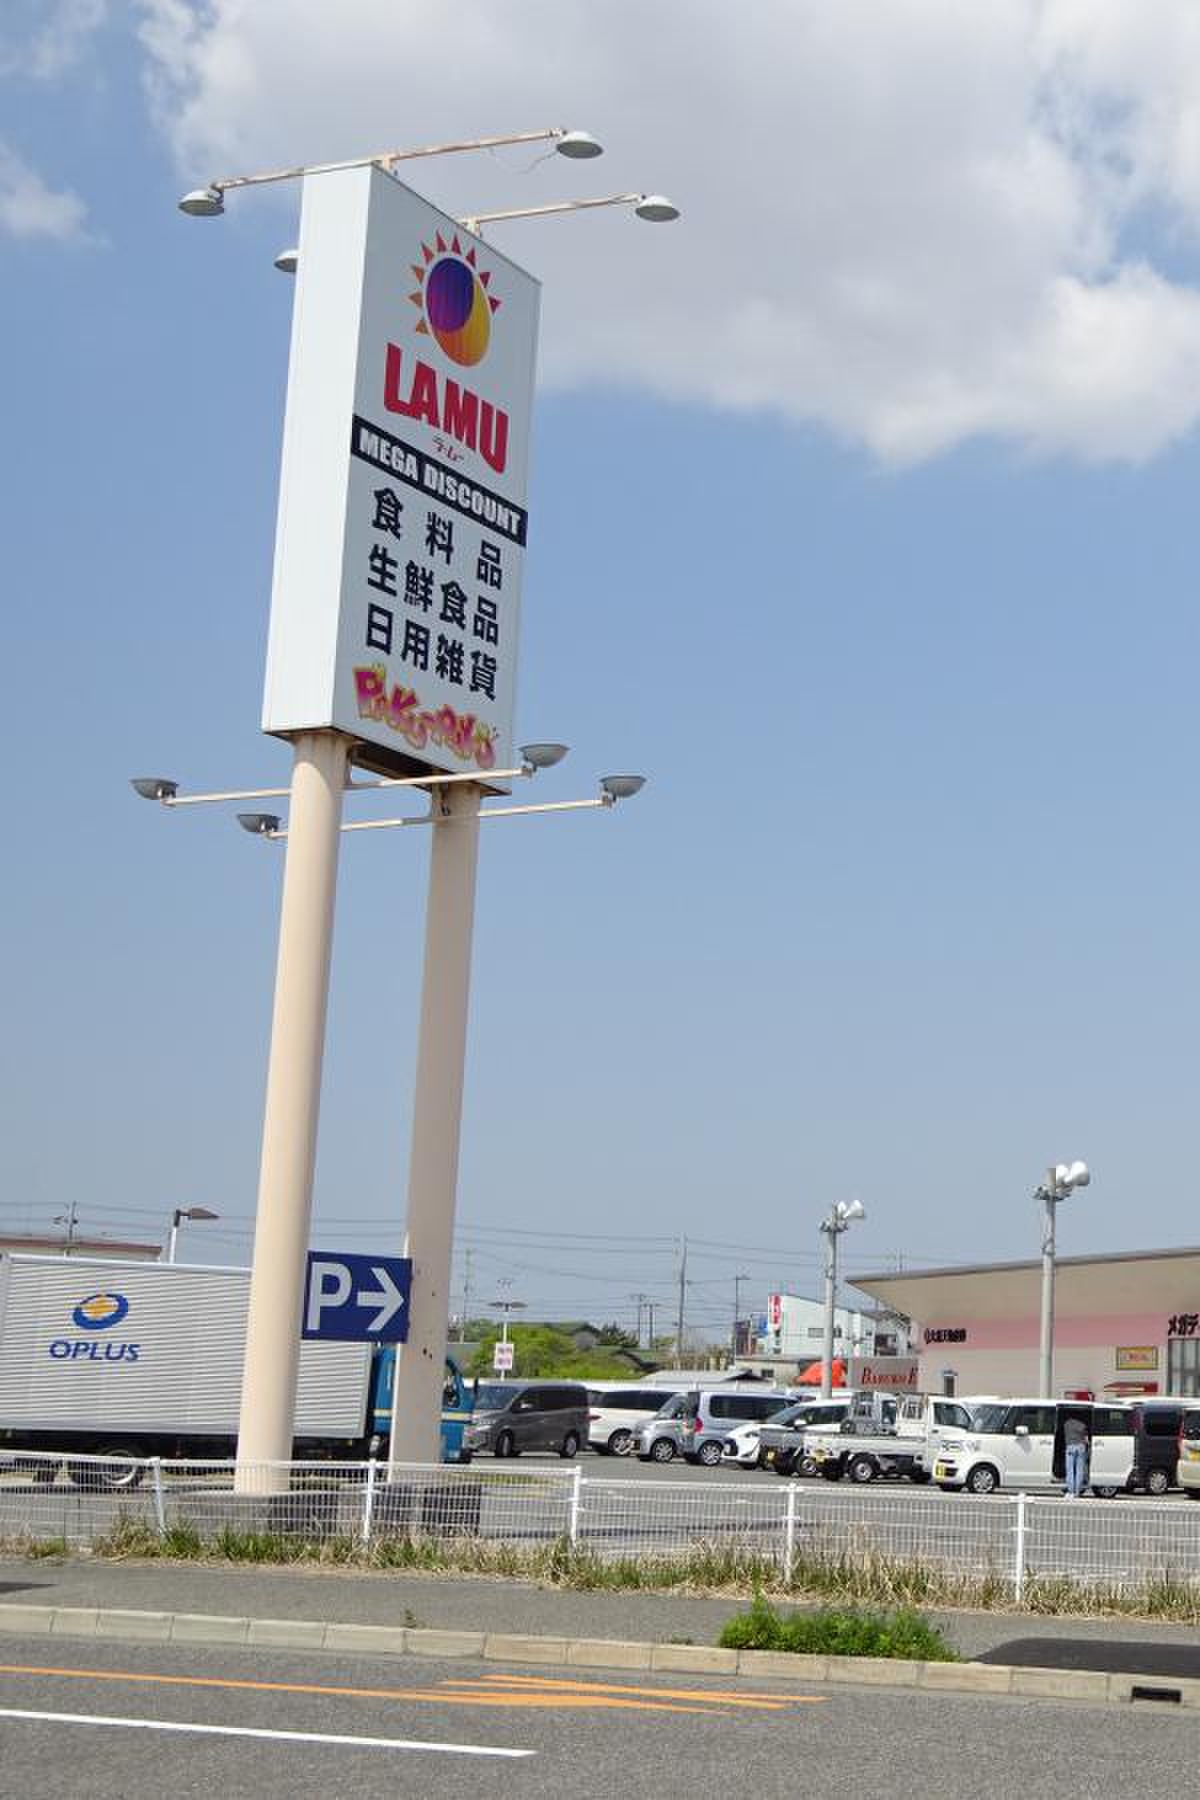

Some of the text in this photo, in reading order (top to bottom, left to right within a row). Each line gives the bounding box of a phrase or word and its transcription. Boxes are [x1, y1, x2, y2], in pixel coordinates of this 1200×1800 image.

[384, 342, 509, 474] LAMU
[359, 428, 521, 536] MEGA DISCOUNT
[372, 488, 503, 590] 食料品
[368, 544, 498, 646] 生鮮食品
[366, 602, 497, 701] 日用雑貨
[307, 1262, 352, 1331] P
[49, 1341, 141, 1361] OPLUS
